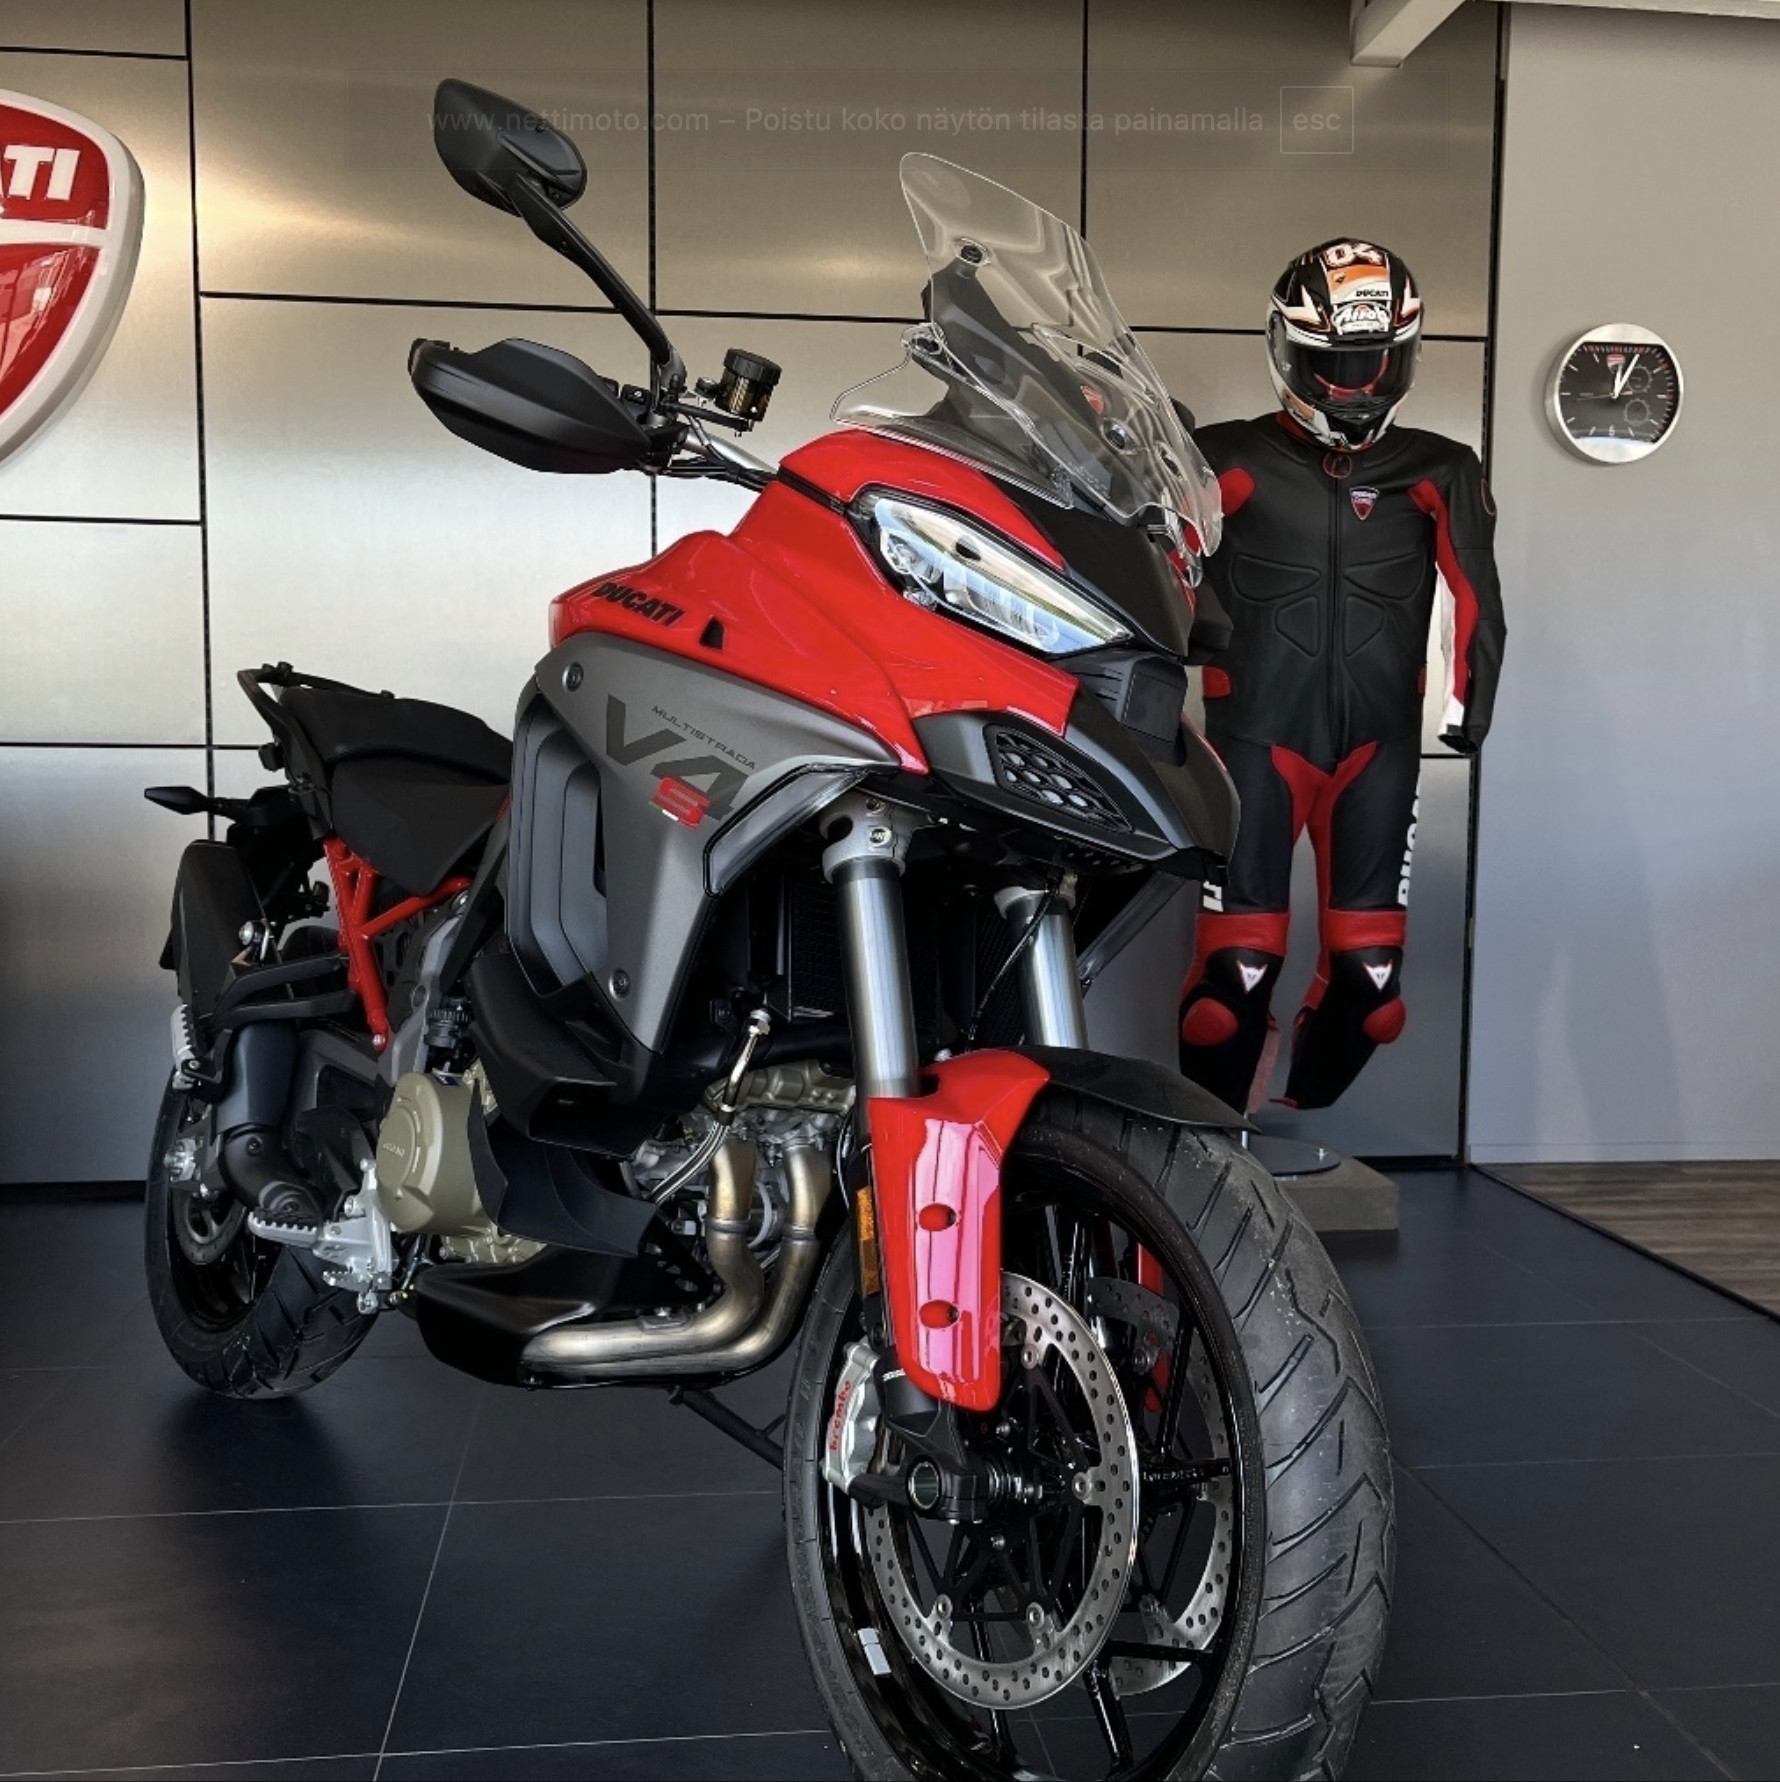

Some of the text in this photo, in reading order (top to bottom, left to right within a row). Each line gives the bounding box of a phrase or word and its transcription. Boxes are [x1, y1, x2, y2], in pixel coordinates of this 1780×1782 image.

[0, 145, 80, 201] TI
[591, 582, 685, 627] DUCATI
[651, 705, 756, 770] MULTISTRADA
[829, 1380, 852, 1451] brembo
